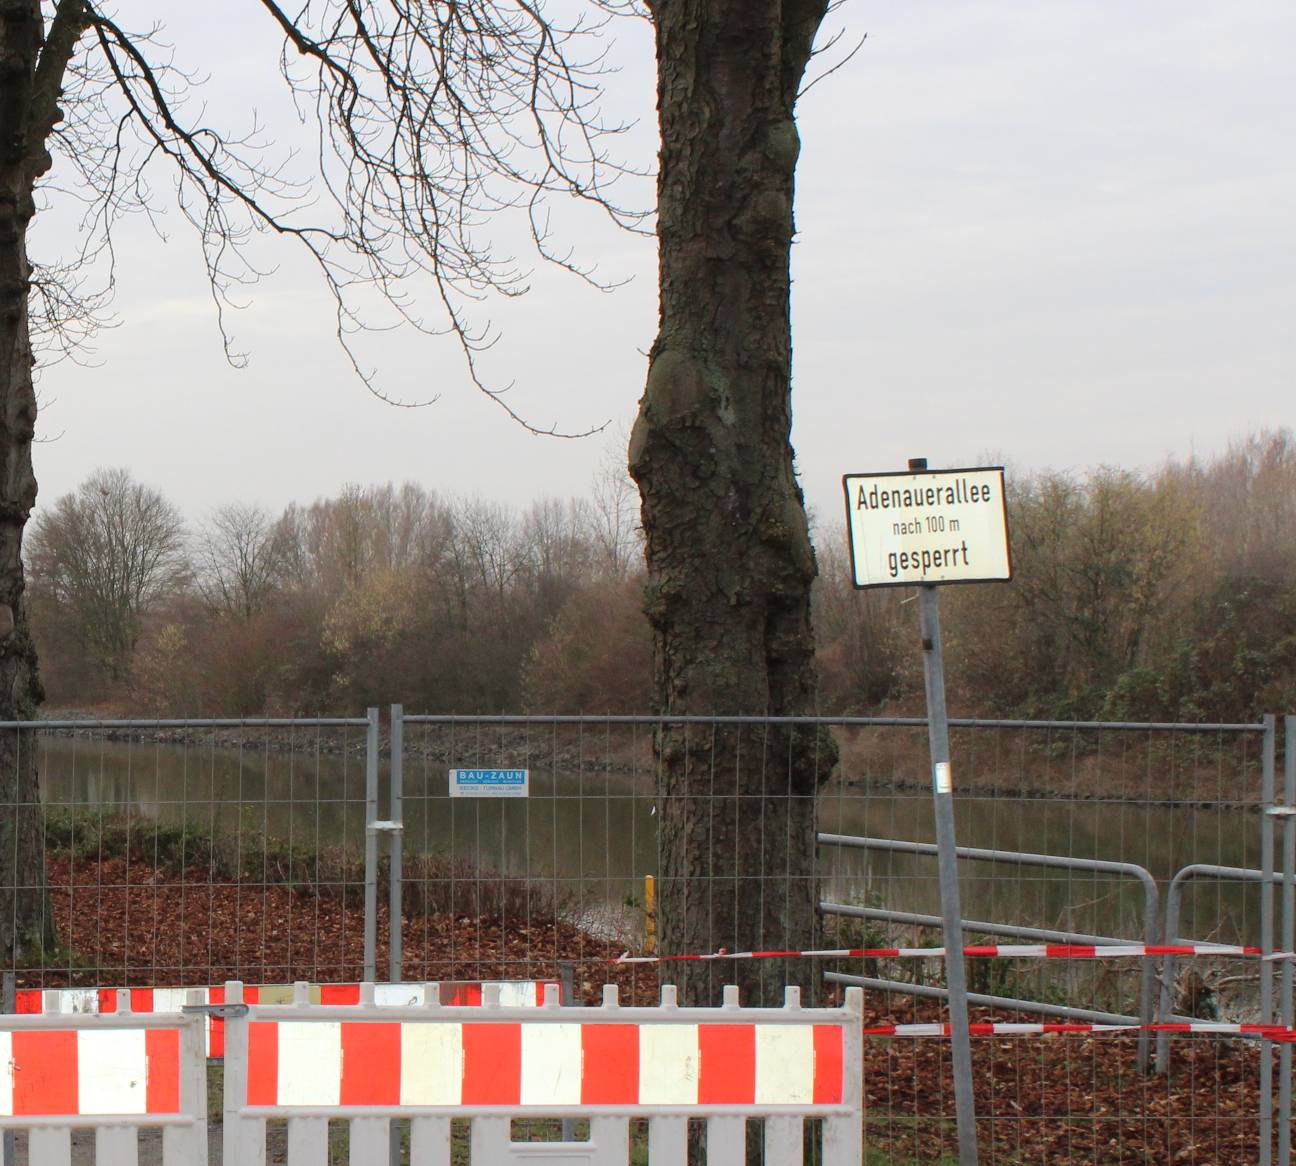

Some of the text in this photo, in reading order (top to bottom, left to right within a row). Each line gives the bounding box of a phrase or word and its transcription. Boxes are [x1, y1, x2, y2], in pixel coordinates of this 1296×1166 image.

[857, 478, 991, 511] Adenauerallee
[892, 515, 961, 535] nach 100 m
[888, 540, 969, 578] gesperrt
